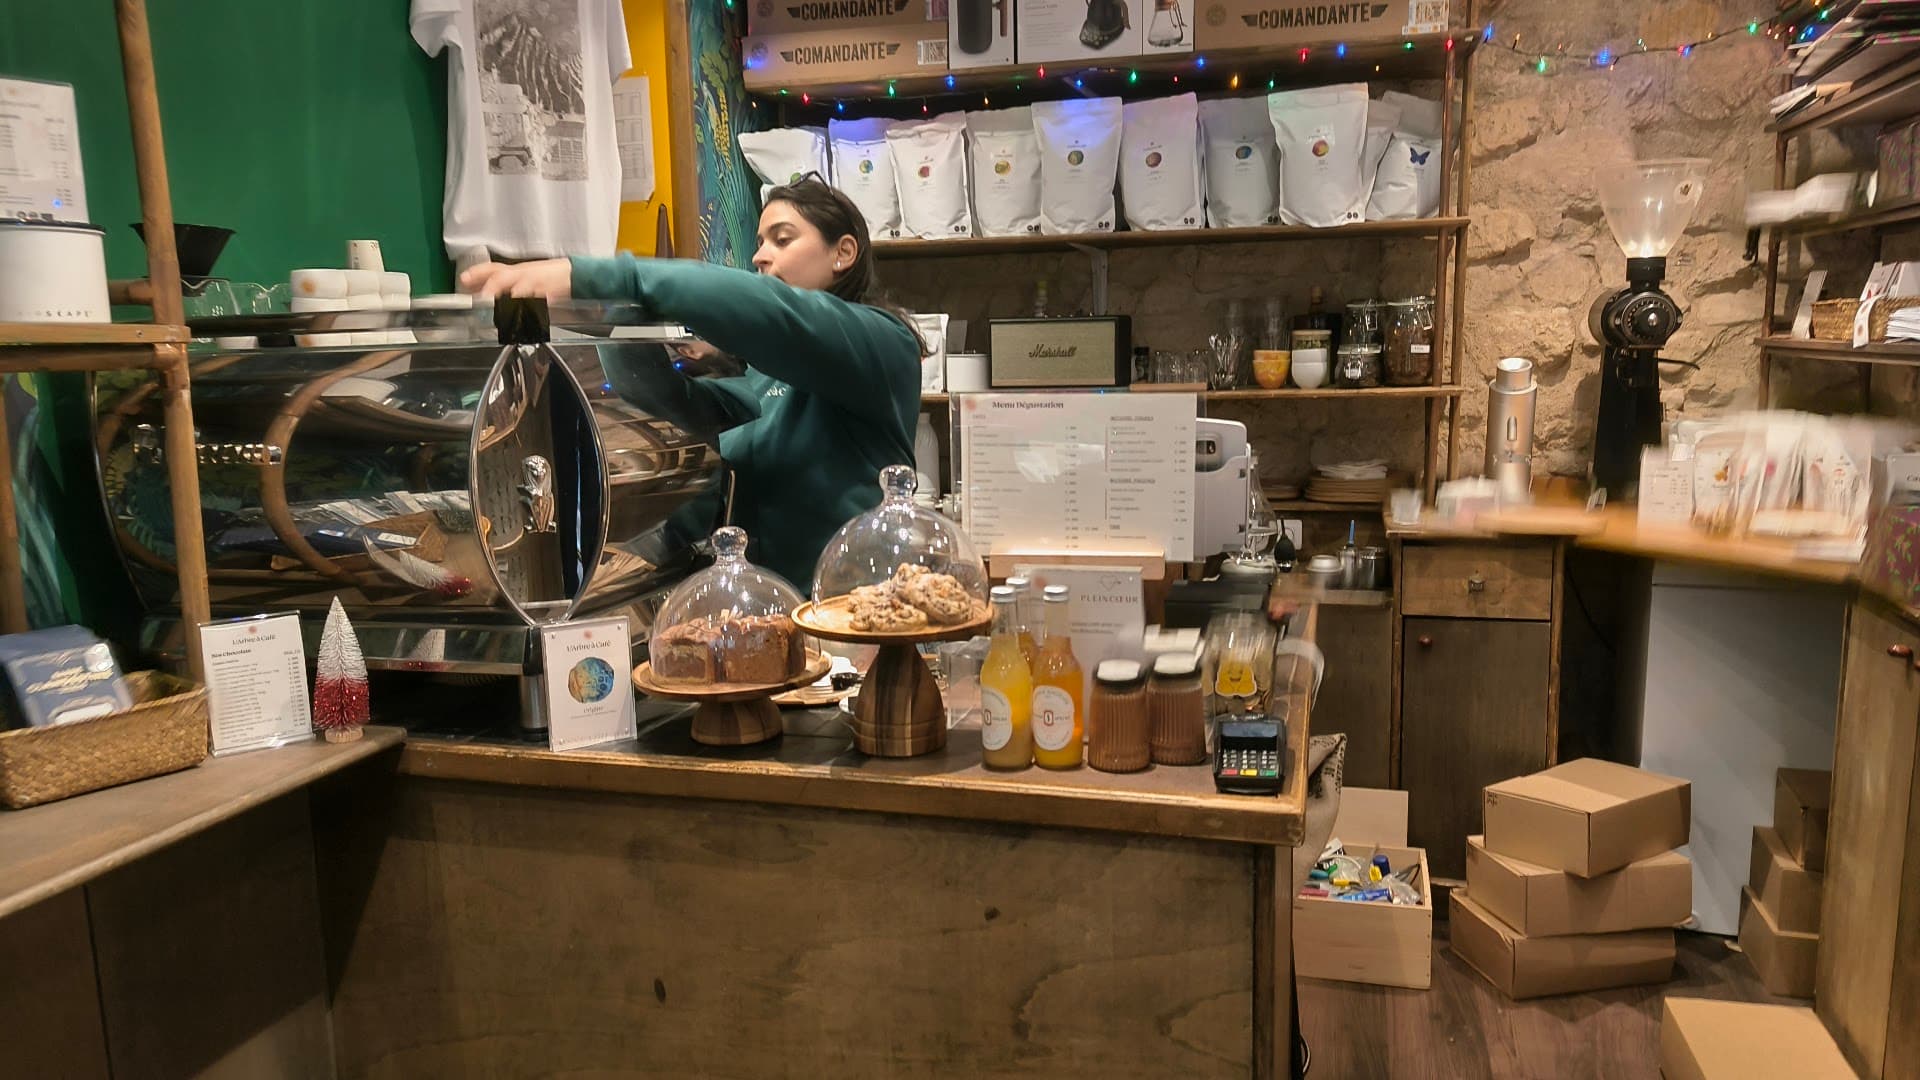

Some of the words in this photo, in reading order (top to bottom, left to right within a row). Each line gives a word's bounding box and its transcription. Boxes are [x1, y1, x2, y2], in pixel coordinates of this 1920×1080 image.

[801, 0, 895, 21] COMANDANTE
[1258, 3, 1370, 29] COMANDANTE
[795, 42, 886, 65] COMANDANTE
[1028, 343, 1077, 358] Marshall
[992, 401, 1015, 409] Menu
